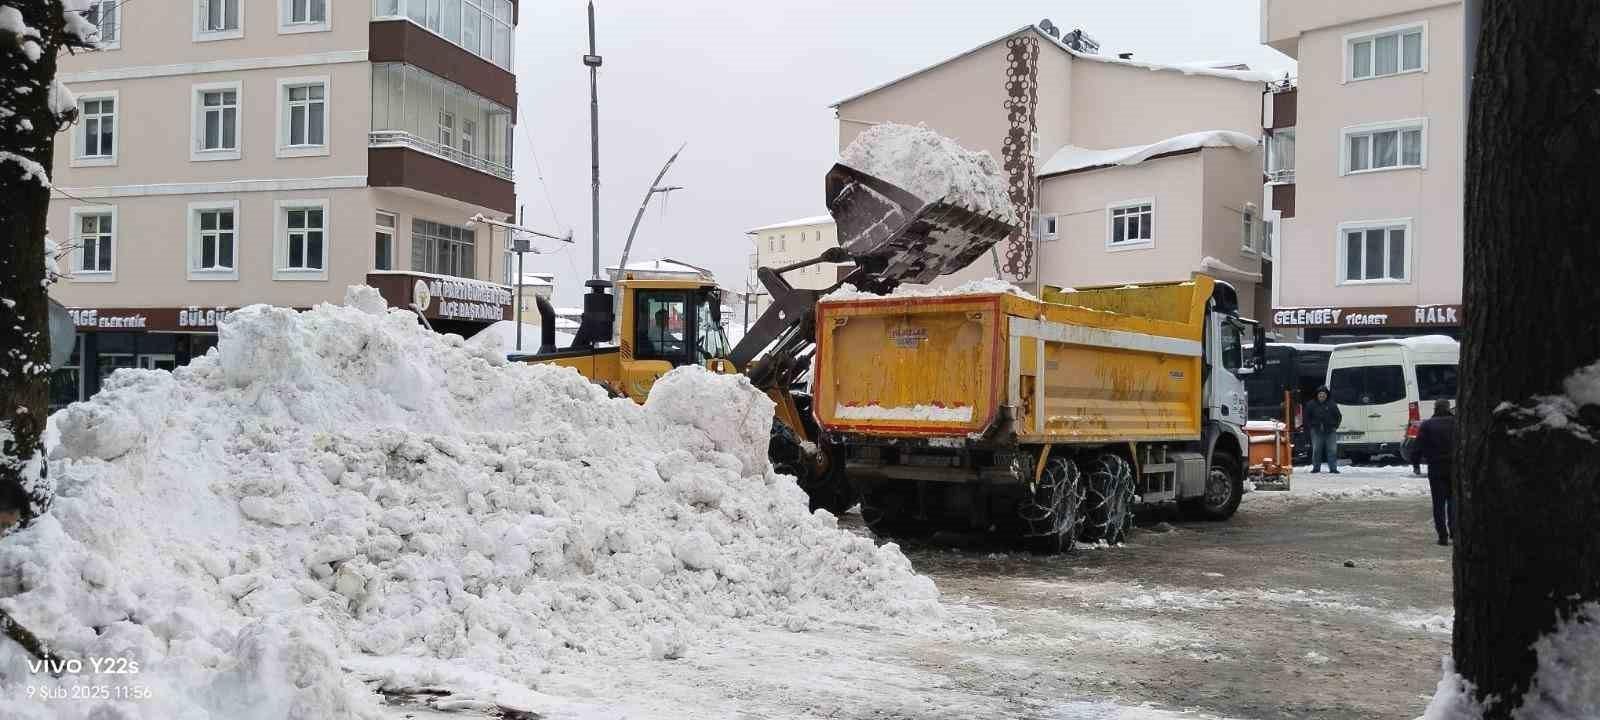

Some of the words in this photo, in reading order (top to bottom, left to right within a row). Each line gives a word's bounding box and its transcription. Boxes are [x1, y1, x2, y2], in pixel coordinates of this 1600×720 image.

[99, 314, 146, 328] ELEKTRİK
[179, 305, 227, 326] BÜLBÜ
[1273, 308, 1342, 325] GELENBEY
[1345, 312, 1388, 325] TİCARET
[1415, 308, 1457, 323] HALK
